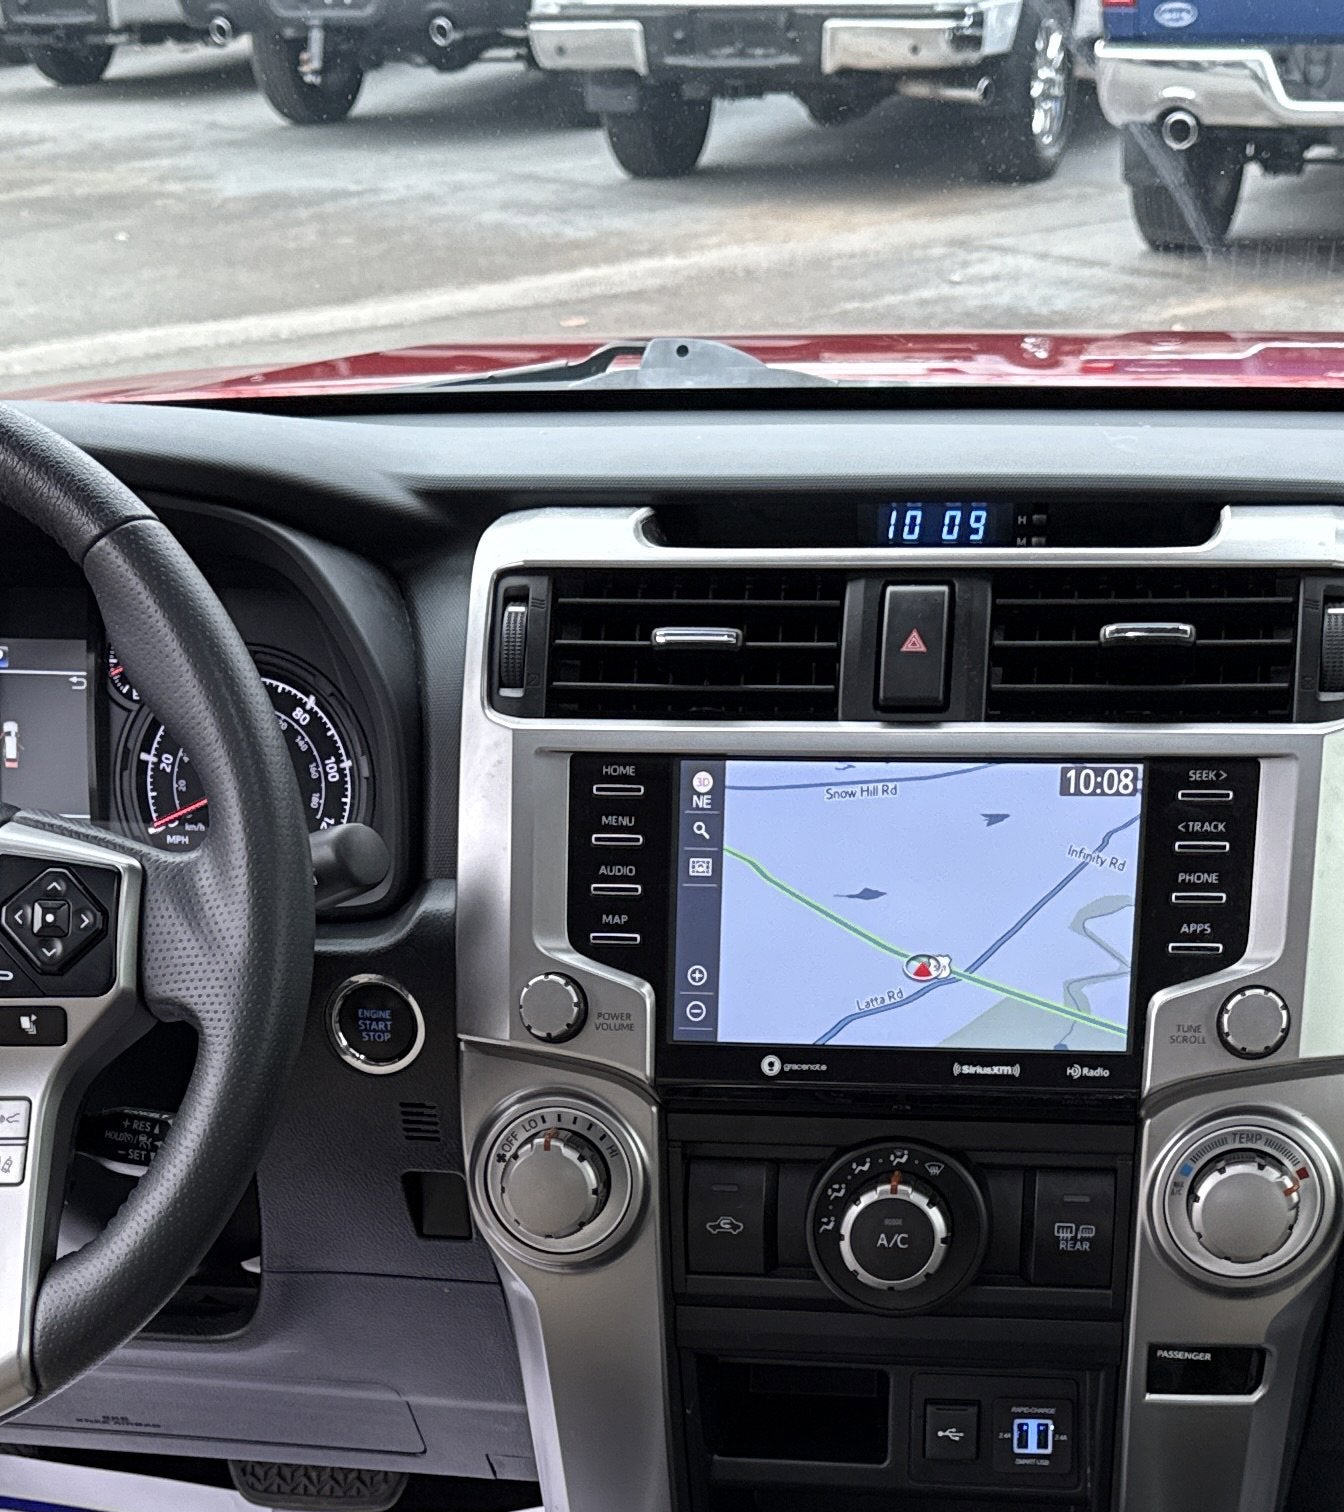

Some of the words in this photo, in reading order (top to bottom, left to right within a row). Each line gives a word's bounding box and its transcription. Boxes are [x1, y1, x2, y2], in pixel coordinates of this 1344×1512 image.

[292, 707, 310, 726] 80
[160, 753, 173, 773] 20
[324, 756, 339, 782] 100
[602, 765, 636, 777] HOME
[1188, 769, 1217, 782] SEEK
[1065, 769, 1135, 795] 10:08
[825, 787, 857, 800] Snow
[859, 785, 880, 799] Hill
[882, 784, 898, 797] Rd
[692, 795, 712, 809] NE
[601, 815, 635, 827] MENU
[1188, 821, 1227, 833] TRACK
[166, 835, 190, 845] MPH
[1067, 845, 1108, 870] Infinity
[1108, 855, 1127, 872] Rd
[598, 865, 637, 877] AUDIO
[1177, 872, 1220, 884] PHONE
[601, 914, 628, 926] MAP
[1180, 922, 1211, 935] APPS
[856, 994, 884, 1013] Latta
[884, 987, 904, 1003] Rd
[358, 1008, 392, 1019] ENGINE
[596, 1011, 632, 1022] POWER
[358, 1020, 393, 1031] START
[594, 1021, 636, 1032] VOLUME
[1176, 1023, 1203, 1034] TUNE
[362, 1031, 392, 1042] STOP
[1169, 1034, 1207, 1046] SCROLL
[783, 1062, 828, 1072] gracenote
[1082, 1066, 1110, 1078] Radio
[132, 1119, 152, 1132] RES
[521, 1118, 539, 1133] LO
[501, 1131, 520, 1153] OFF
[1231, 1132, 1263, 1145] TEMP
[127, 1149, 148, 1161] SET
[607, 1144, 619, 1159] HI
[876, 1233, 909, 1249] A/C
[1059, 1241, 1090, 1251] REAR
[1157, 1350, 1212, 1361] PASSENGER
